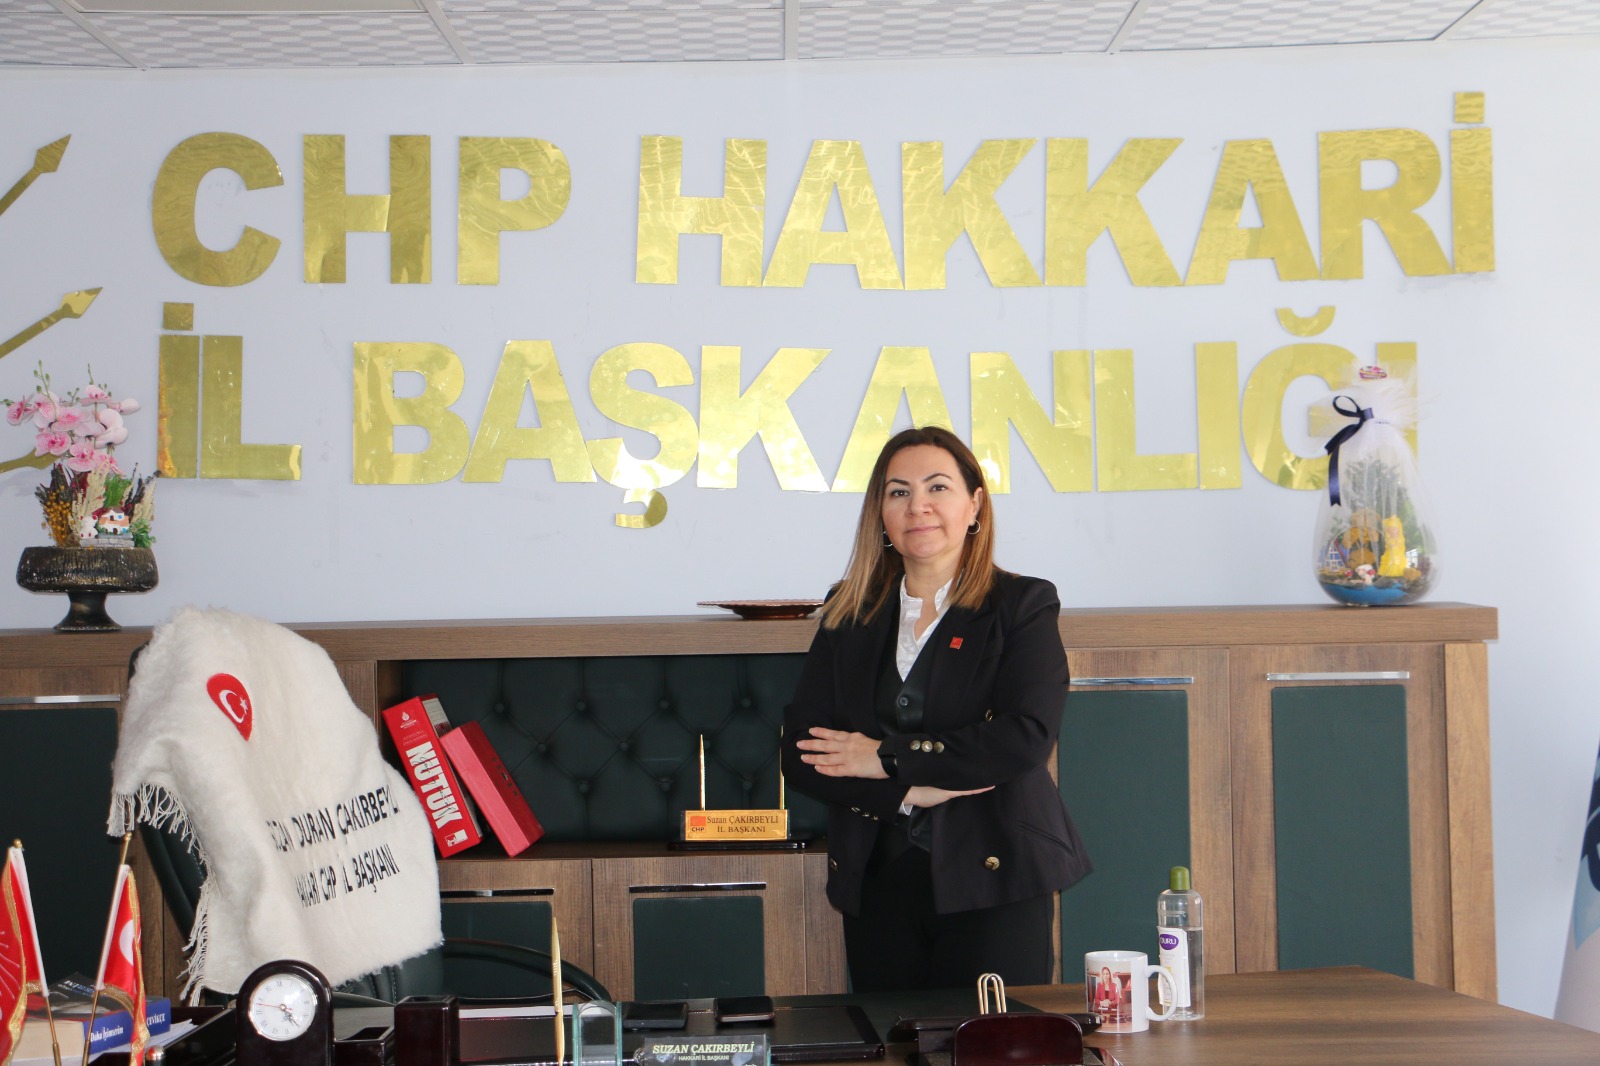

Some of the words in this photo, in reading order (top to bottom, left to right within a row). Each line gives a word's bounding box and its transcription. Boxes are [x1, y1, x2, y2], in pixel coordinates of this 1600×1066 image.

[152, 130, 571, 286] CHP
[635, 91, 1495, 291] HAKKARİ
[156, 302, 302, 480] İL
[405, 741, 463, 829] NUTUK
[706, 815, 727, 824] Suzan
[728, 814, 779, 825] ÇAKIRBEYLİ
[717, 825, 726, 833] İL
[728, 826, 766, 834] BAŞKANI
[352, 843, 401, 893] BAŞKANI
[652, 1044, 690, 1054] SUZAN
[690, 1041, 755, 1055] ÇAKIRBEYLİ
